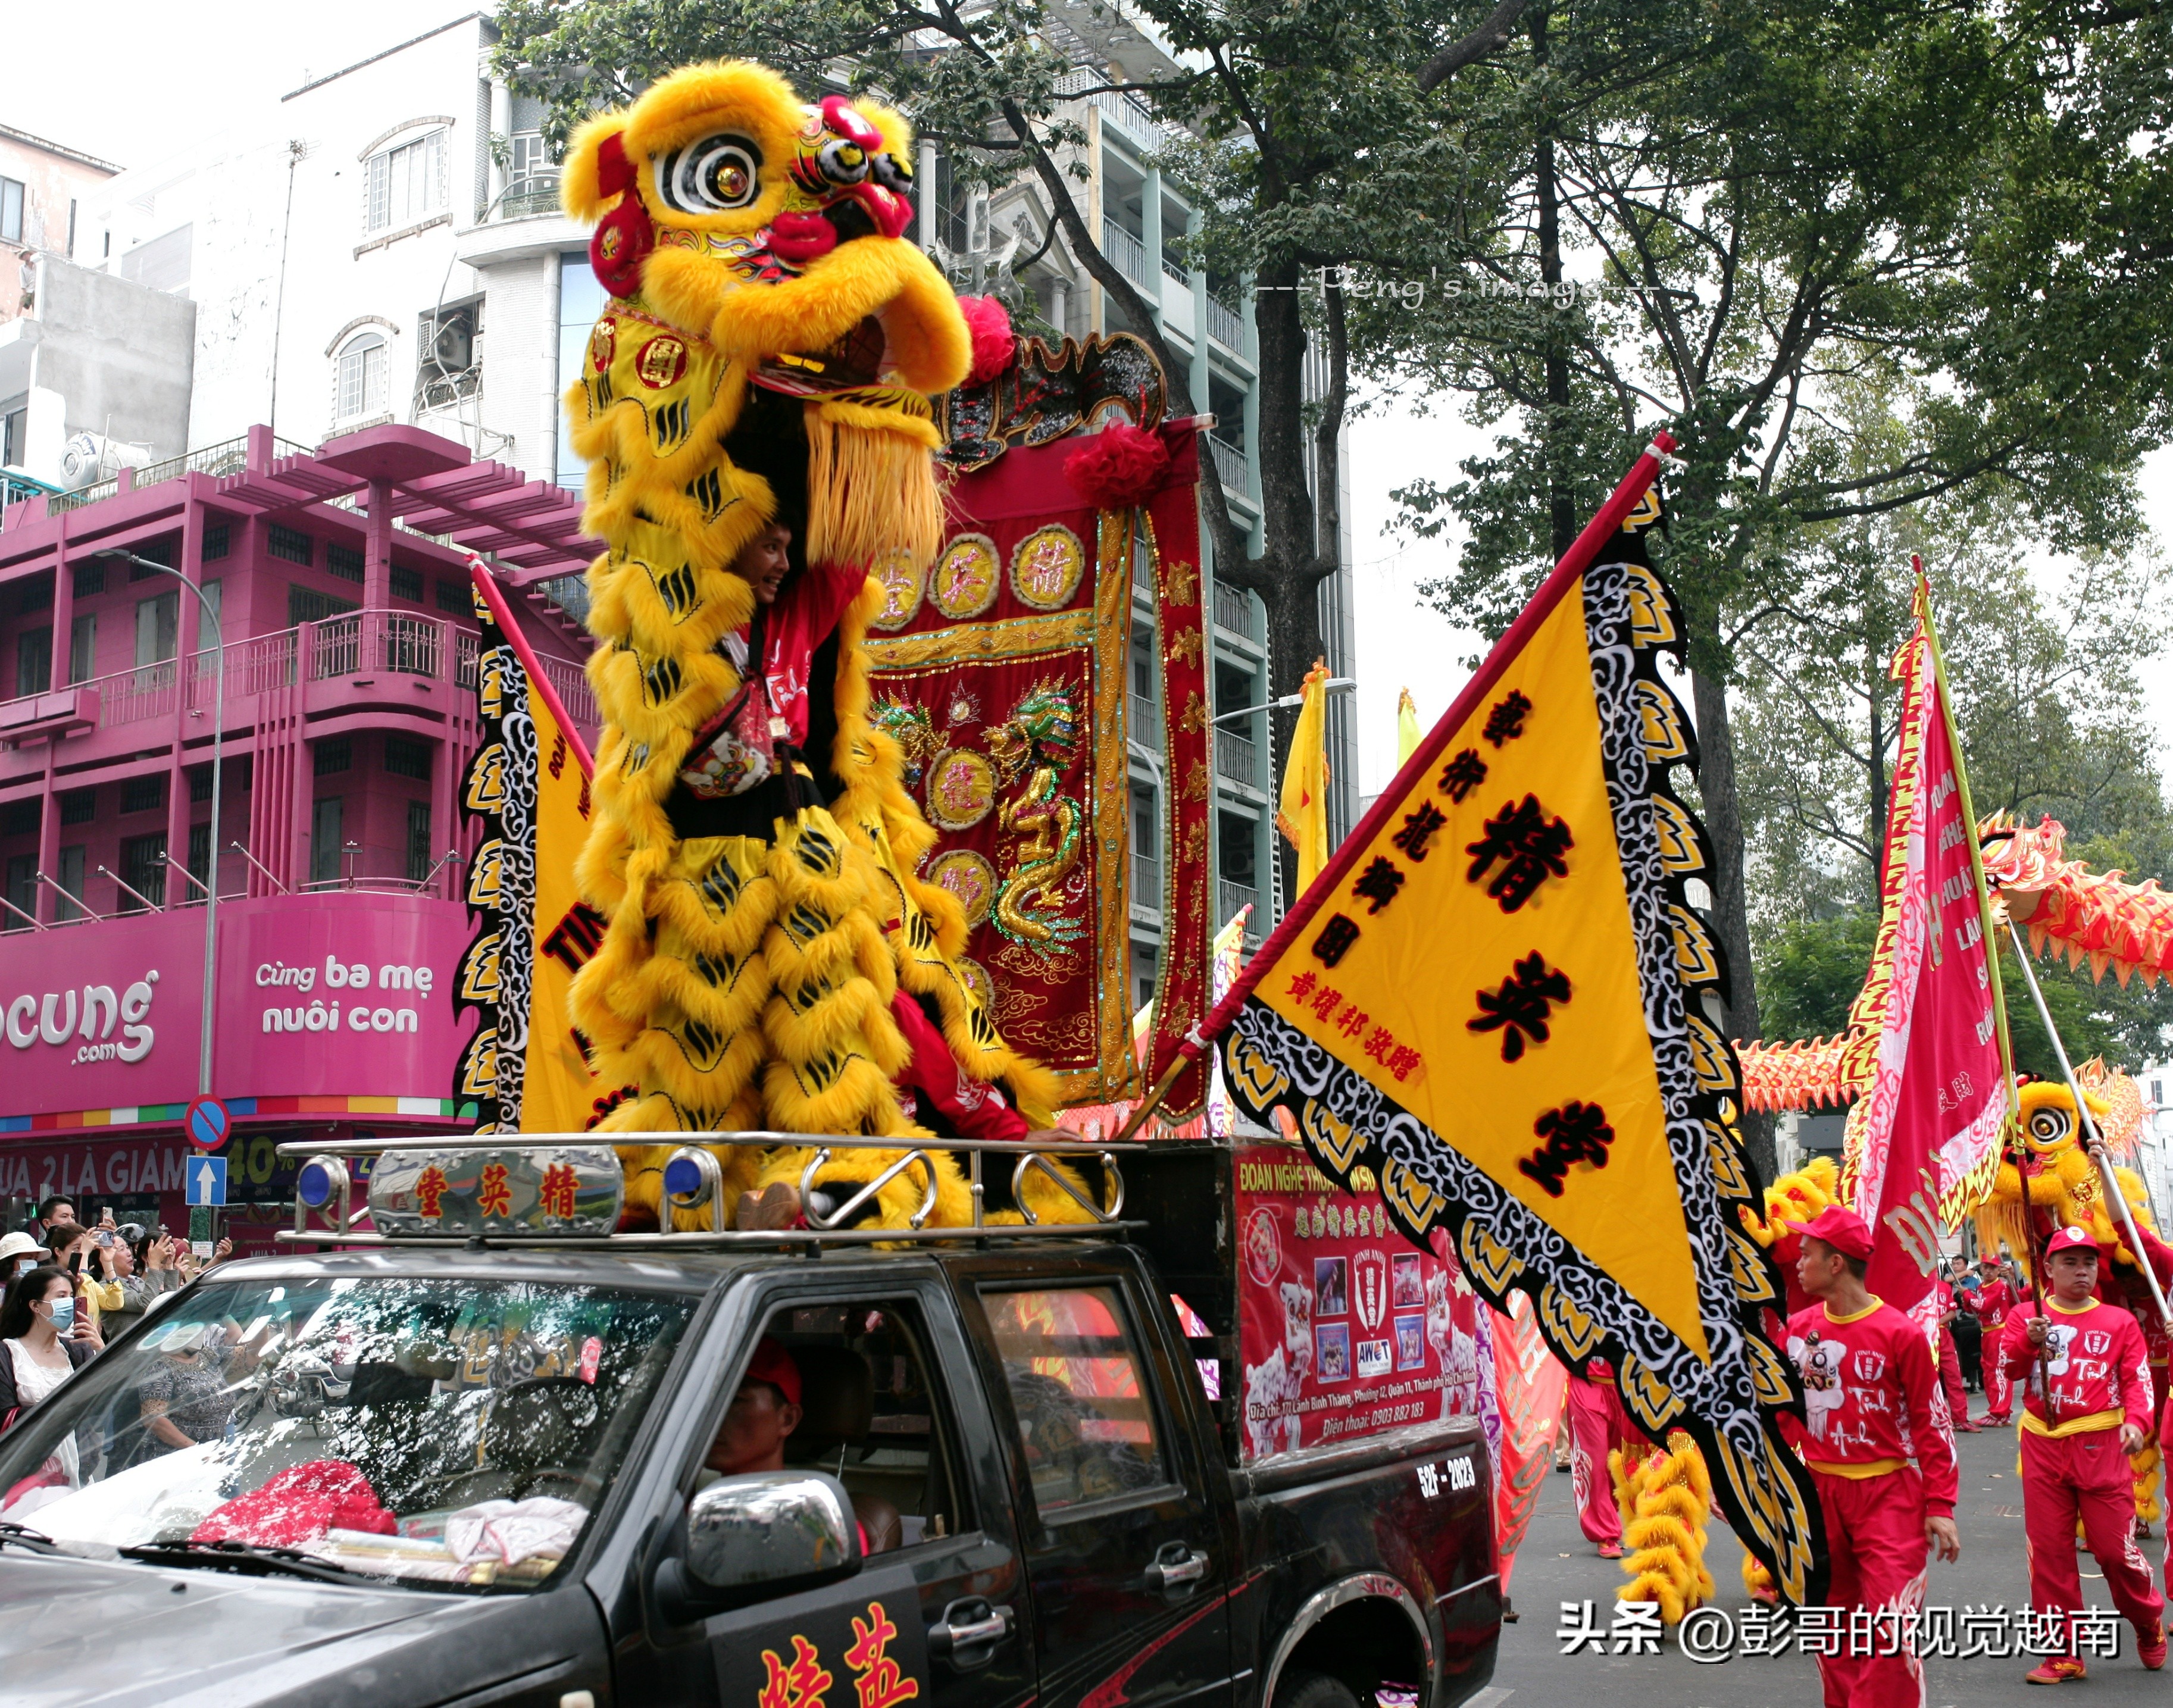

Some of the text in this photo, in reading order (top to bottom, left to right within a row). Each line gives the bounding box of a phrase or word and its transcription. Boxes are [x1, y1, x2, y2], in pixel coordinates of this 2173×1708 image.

[256, 955, 433, 999] Cùng ba mẹ
[1465, 793, 1615, 1198] 精英堂
[262, 999, 418, 1033] nuôi con
[71, 1043, 117, 1066] .com
[62, 1146, 99, 1194] LÀ
[1240, 1157, 1272, 1191] ĐOÀN
[1371, 1407, 1393, 1427] 0903
[1411, 1401, 1424, 1418] 183
[1417, 1463, 1439, 1499] 52F
